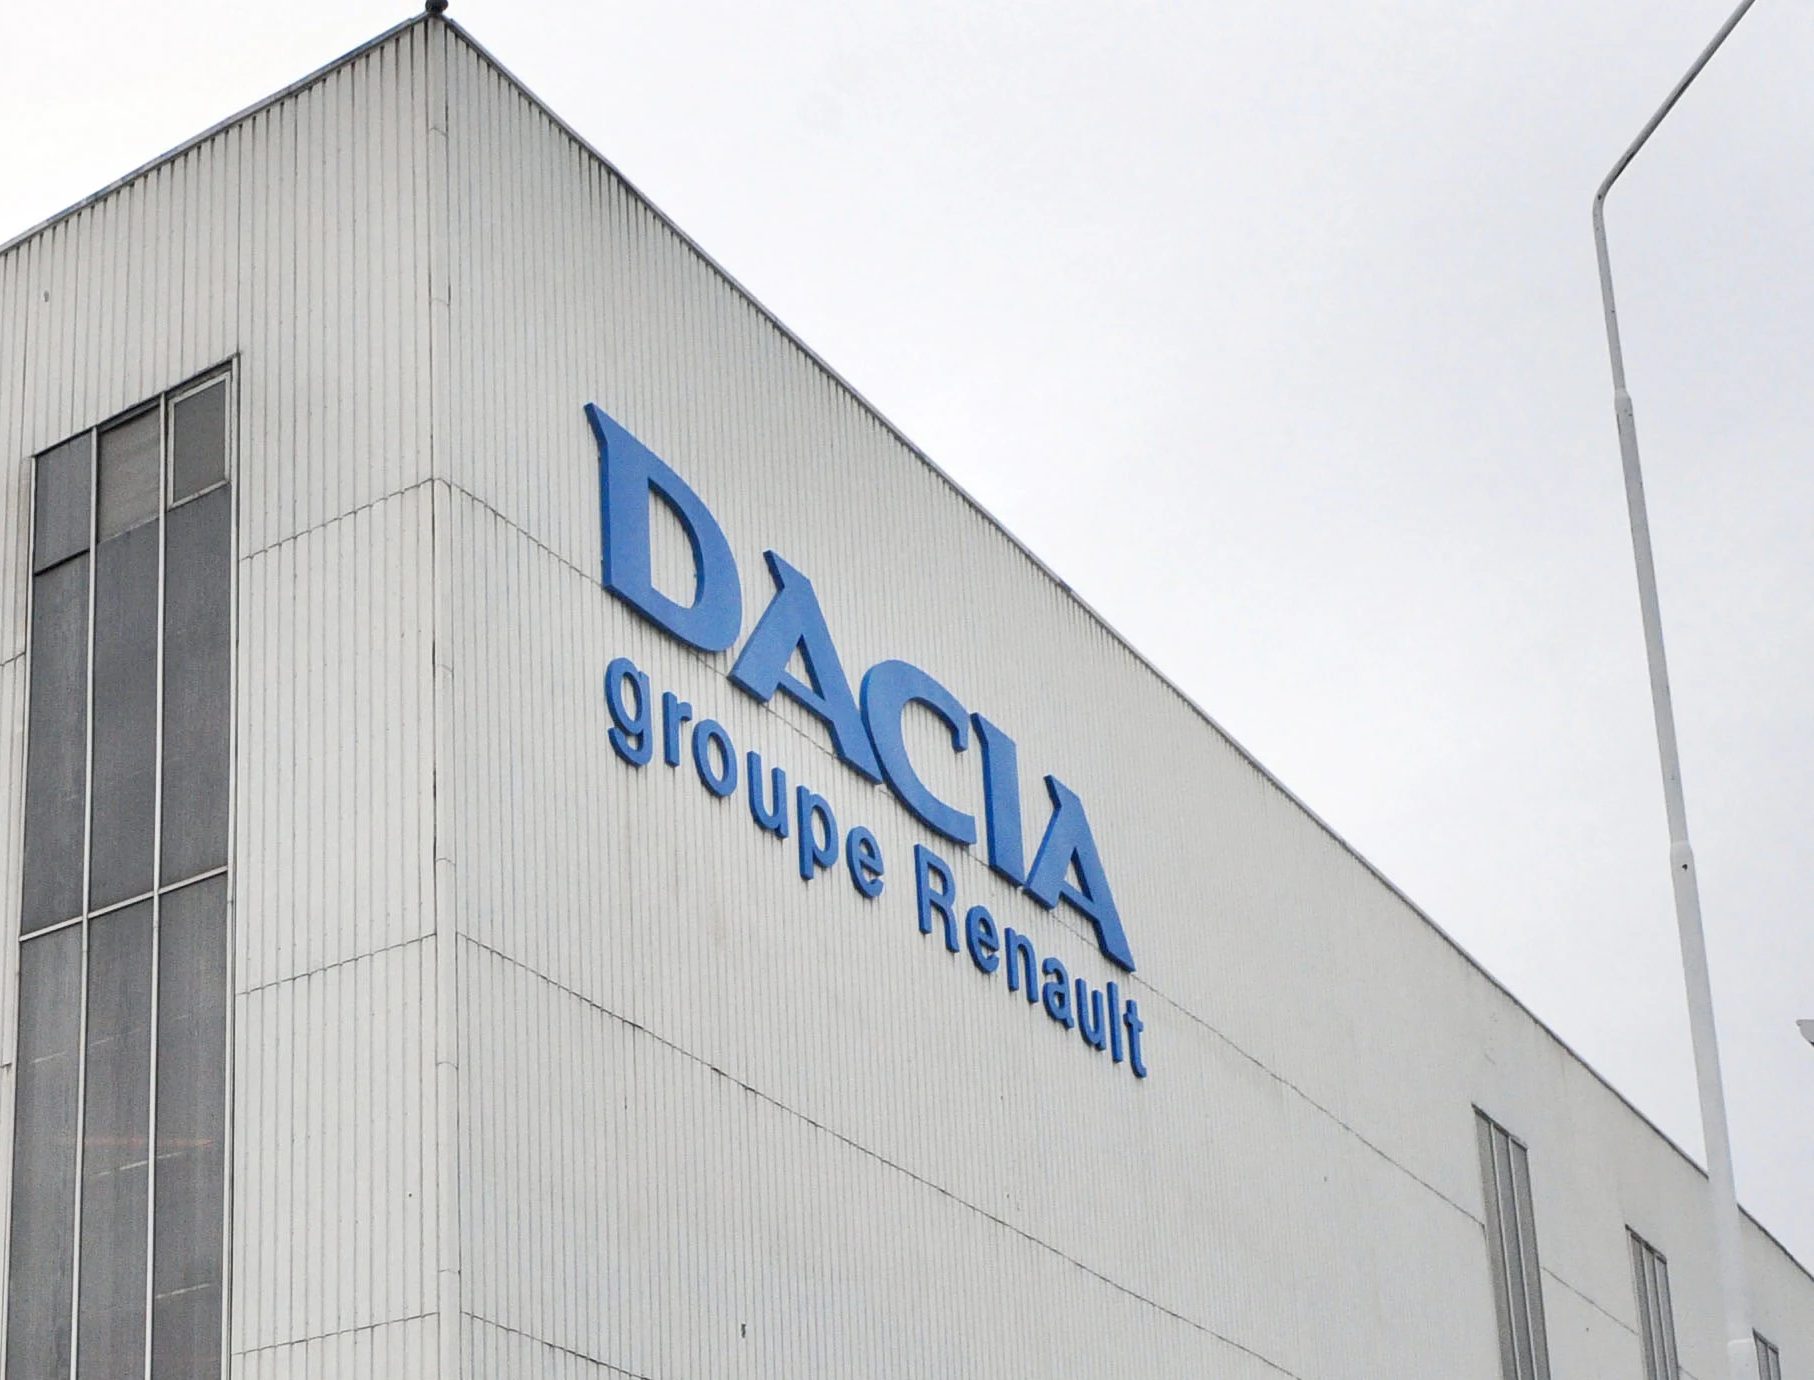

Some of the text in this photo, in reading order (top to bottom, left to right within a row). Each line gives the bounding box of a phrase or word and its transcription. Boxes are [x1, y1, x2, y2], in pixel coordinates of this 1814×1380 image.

[584, 403, 1136, 972] DACIA
[604, 657, 1147, 1077] groupe Renault
